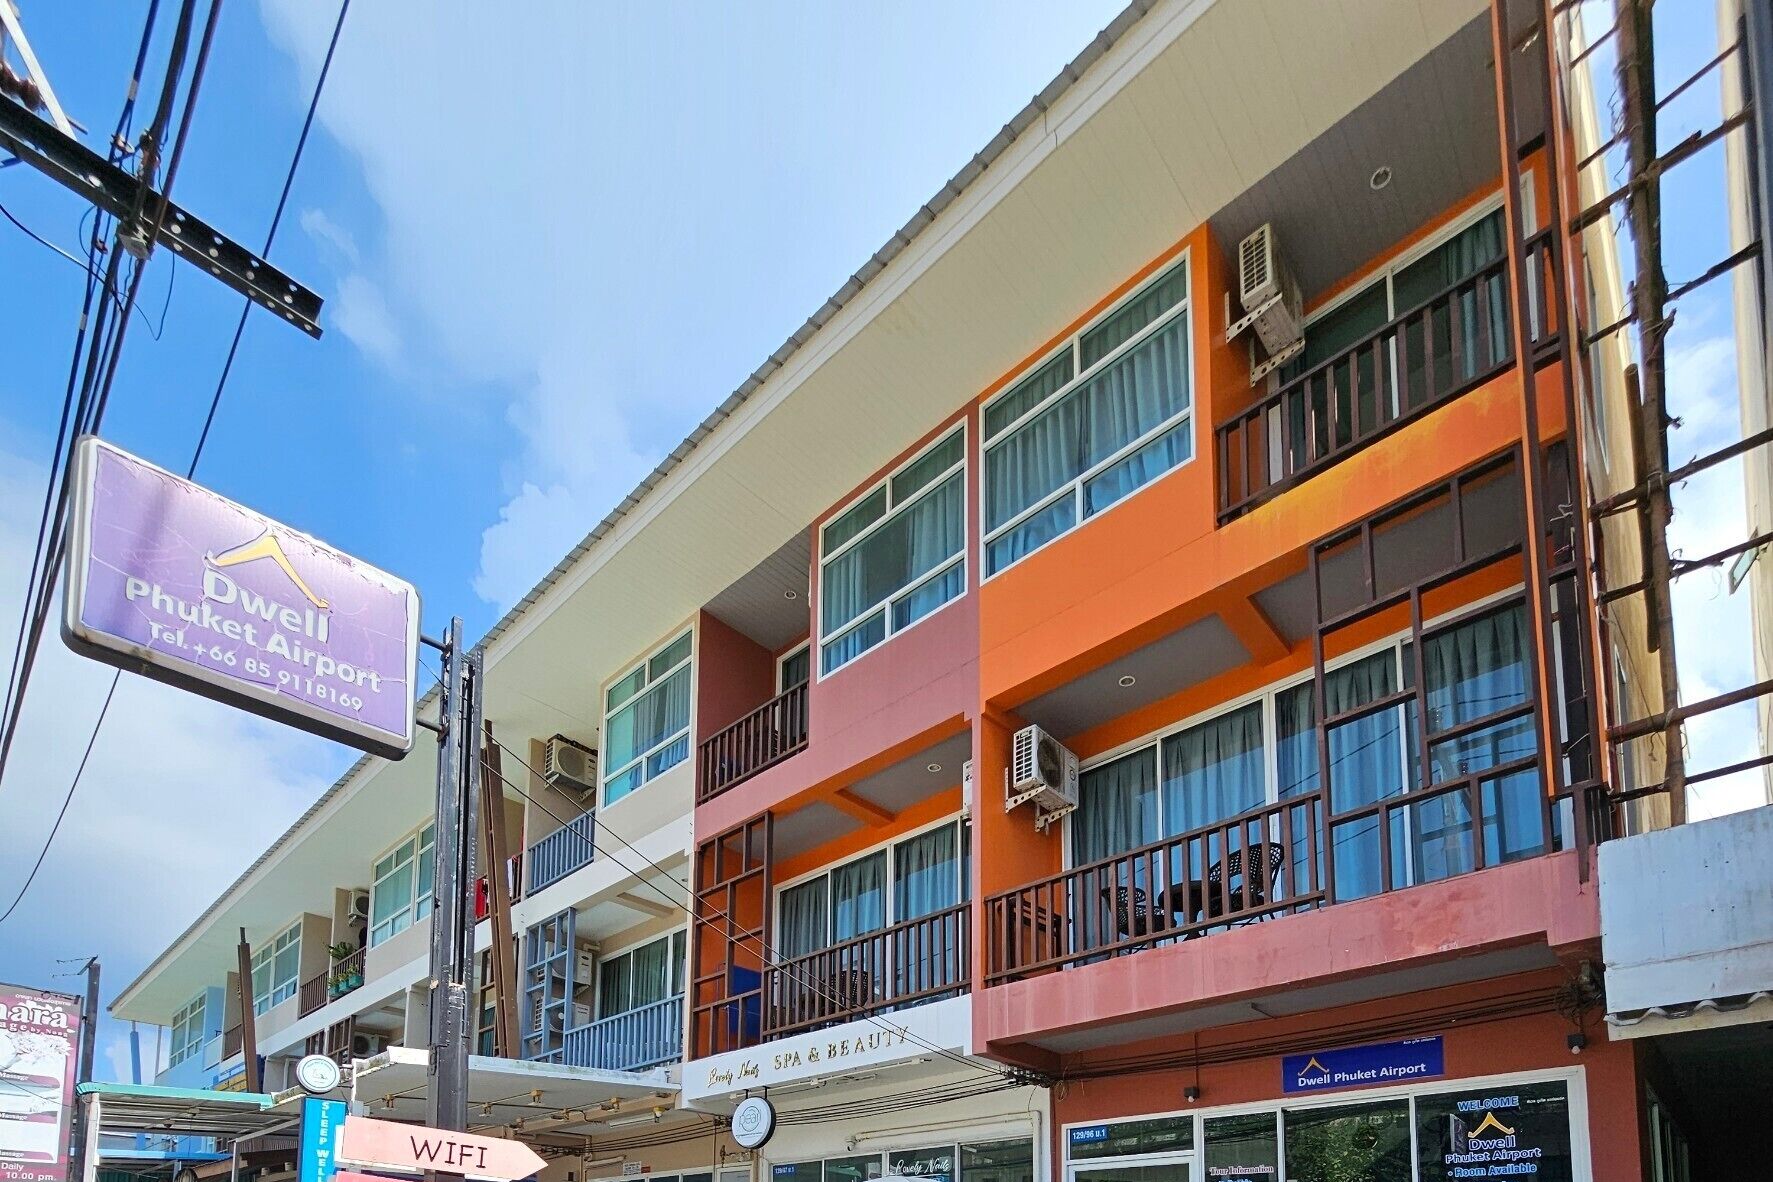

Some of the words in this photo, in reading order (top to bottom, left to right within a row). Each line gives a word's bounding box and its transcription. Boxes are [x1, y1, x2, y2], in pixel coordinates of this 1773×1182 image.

[202, 567, 329, 643] Dwell
[125, 577, 257, 647] Phuket
[265, 632, 382, 694] Airport
[149, 621, 188, 649] Tel.
[193, 641, 237, 667] +66
[244, 657, 271, 679] 85
[278, 671, 364, 711] 9118169
[774, 1050, 802, 1070] SPA
[808, 1048, 820, 1063] &
[827, 1026, 909, 1060] BEAUTY
[1298, 1074, 1330, 1087] Dwell
[1334, 1069, 1376, 1083] Phuket
[1379, 1063, 1426, 1077] Airport
[1457, 1096, 1519, 1112] WELCOME
[319, 1102, 330, 1145] SLEEP
[1072, 1130, 1094, 1140] 129/96
[1468, 1135, 1516, 1151] Dwell
[410, 1135, 487, 1169] WIFI
[1445, 1152, 1490, 1164] Phuket
[1492, 1147, 1541, 1161] Airport
[1, 1163, 24, 1172] Daily
[924, 1158, 951, 1174] Nails
[1229, 1164, 1274, 1175] Information
[1455, 1167, 1486, 1178] Room
[1488, 1163, 1537, 1176] Available
[6, 1172, 34, 1181] 10.00
[38, 1174, 56, 1182] pm.
